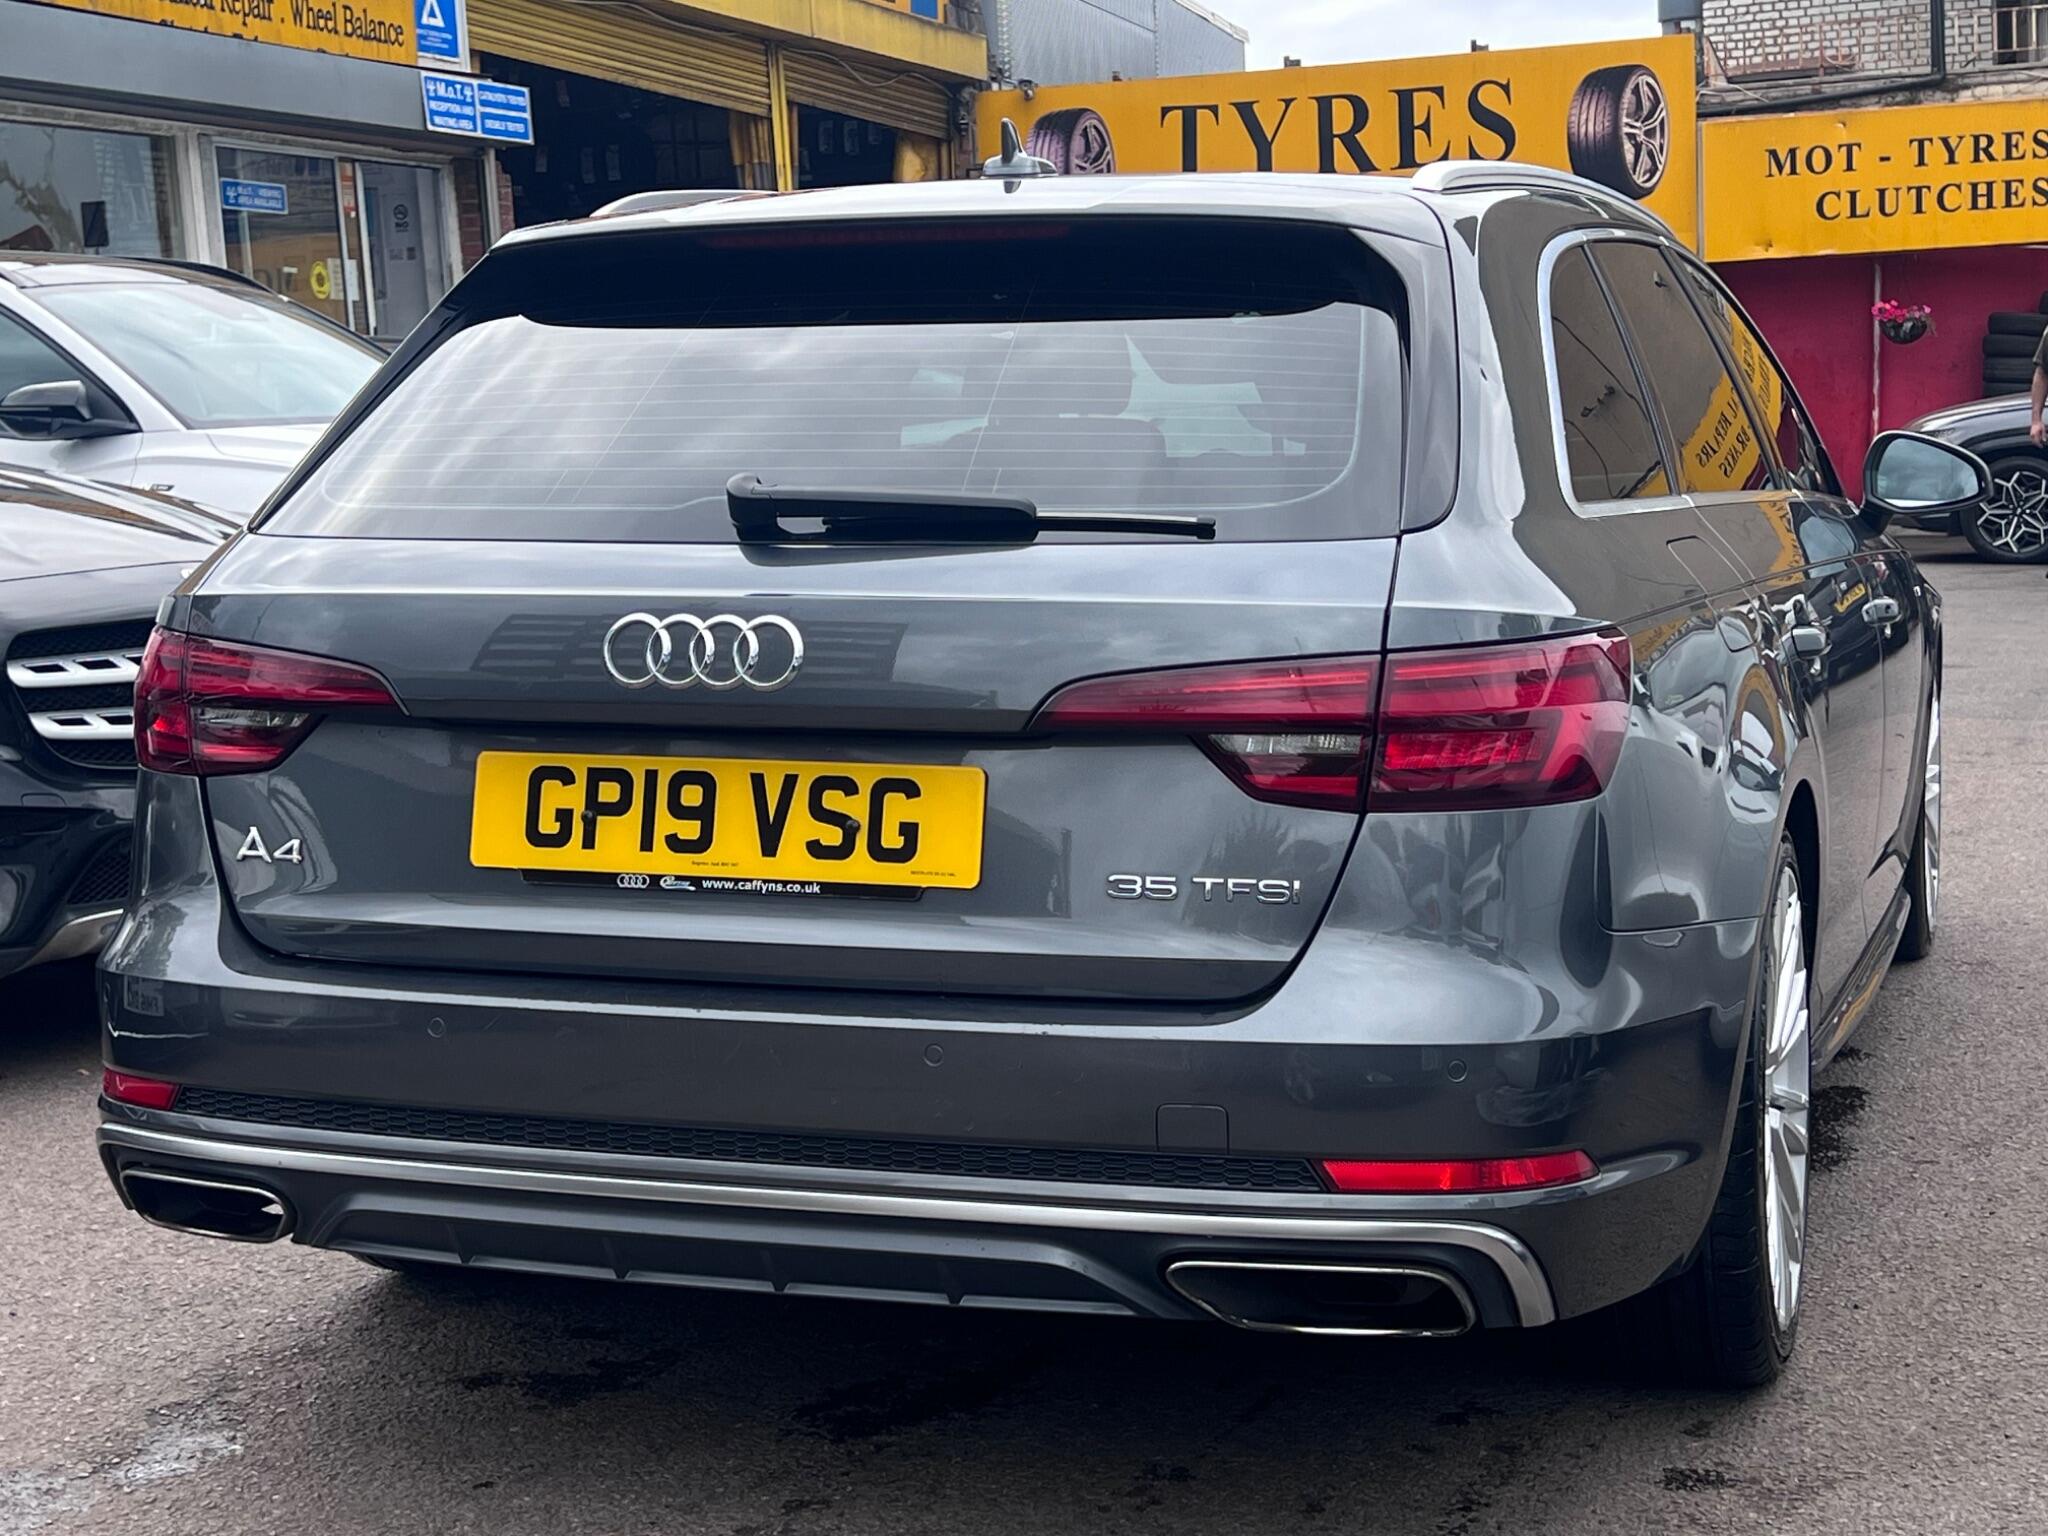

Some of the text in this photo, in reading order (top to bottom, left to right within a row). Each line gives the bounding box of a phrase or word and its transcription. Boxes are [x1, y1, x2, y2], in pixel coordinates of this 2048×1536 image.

[291, 0, 338, 35] Wheel
[343, 9, 404, 47] Balance
[1160, 78, 1517, 173] TYRES
[1765, 143, 1862, 178] MOT
[1909, 129, 2048, 168] TYRES
[1815, 177, 2048, 221] CLUTCHES
[525, 765, 922, 865] GP19 VSG
[236, 826, 303, 864] A4
[701, 879, 821, 895] www.caffyns.co.uk
[1107, 874, 1301, 905] 35 TFSI
